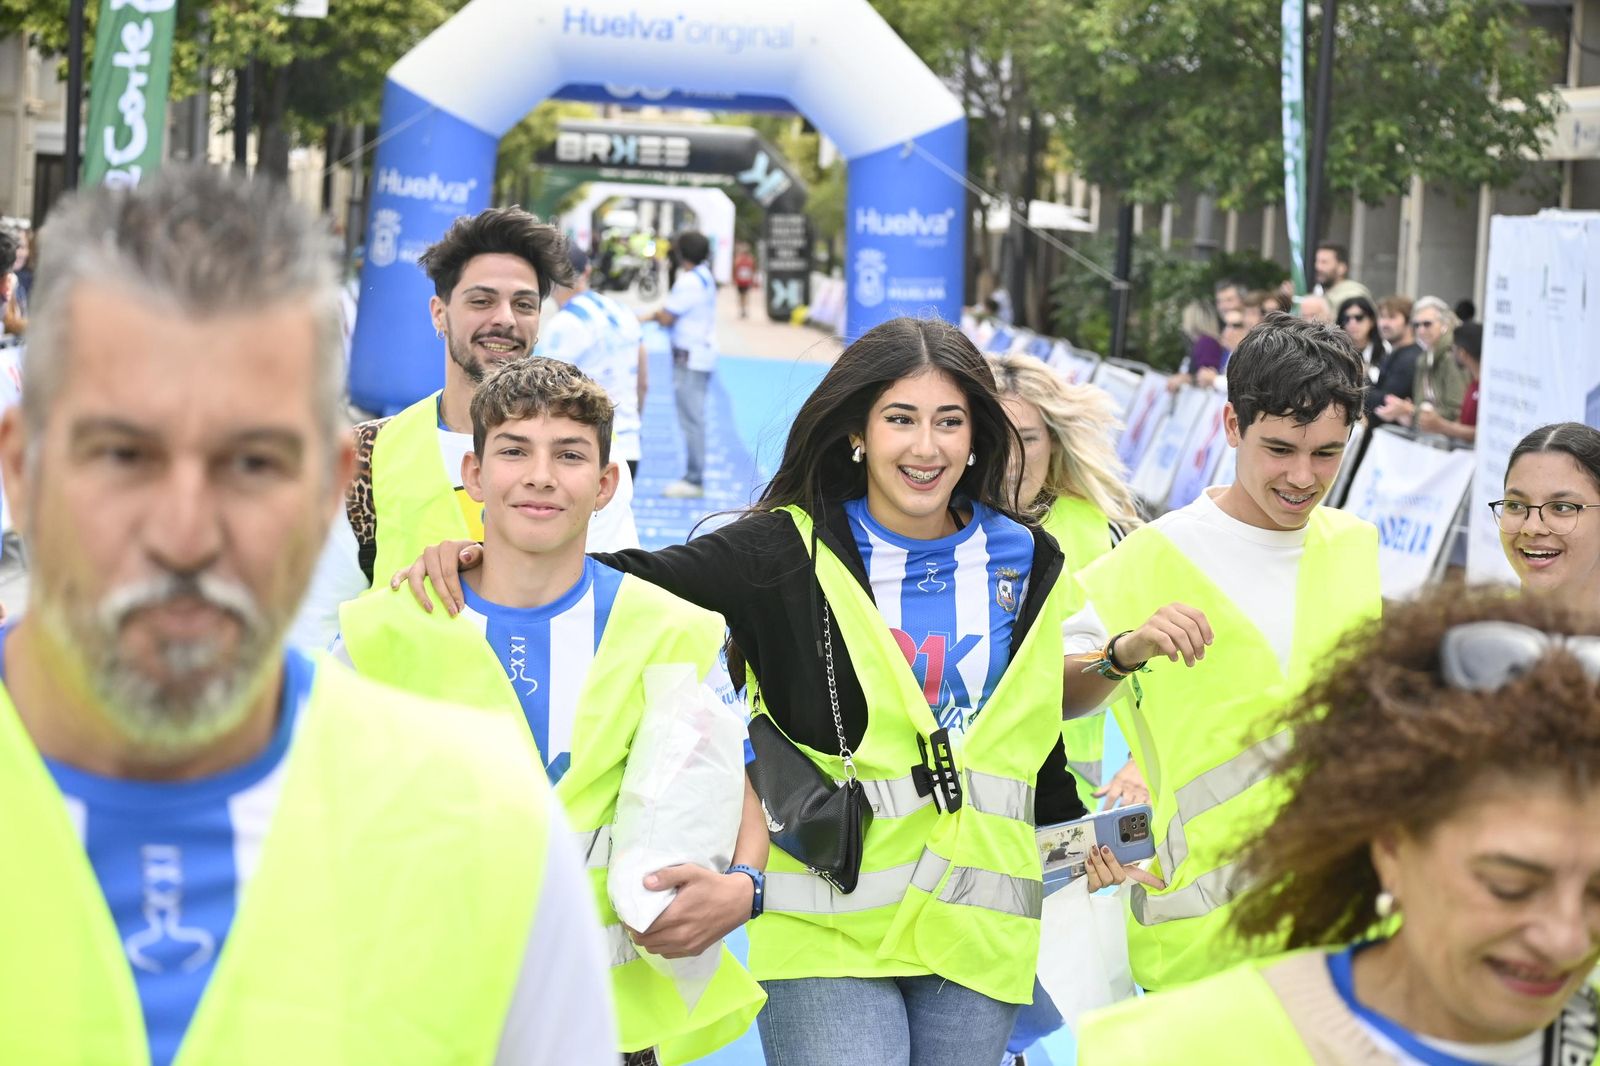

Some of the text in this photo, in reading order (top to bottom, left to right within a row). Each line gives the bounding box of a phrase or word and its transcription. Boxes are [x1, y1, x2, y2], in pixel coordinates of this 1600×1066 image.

[562, 6, 797, 54] Huelva original
[377, 166, 470, 205] Huelva
[855, 206, 950, 236] Huelva
